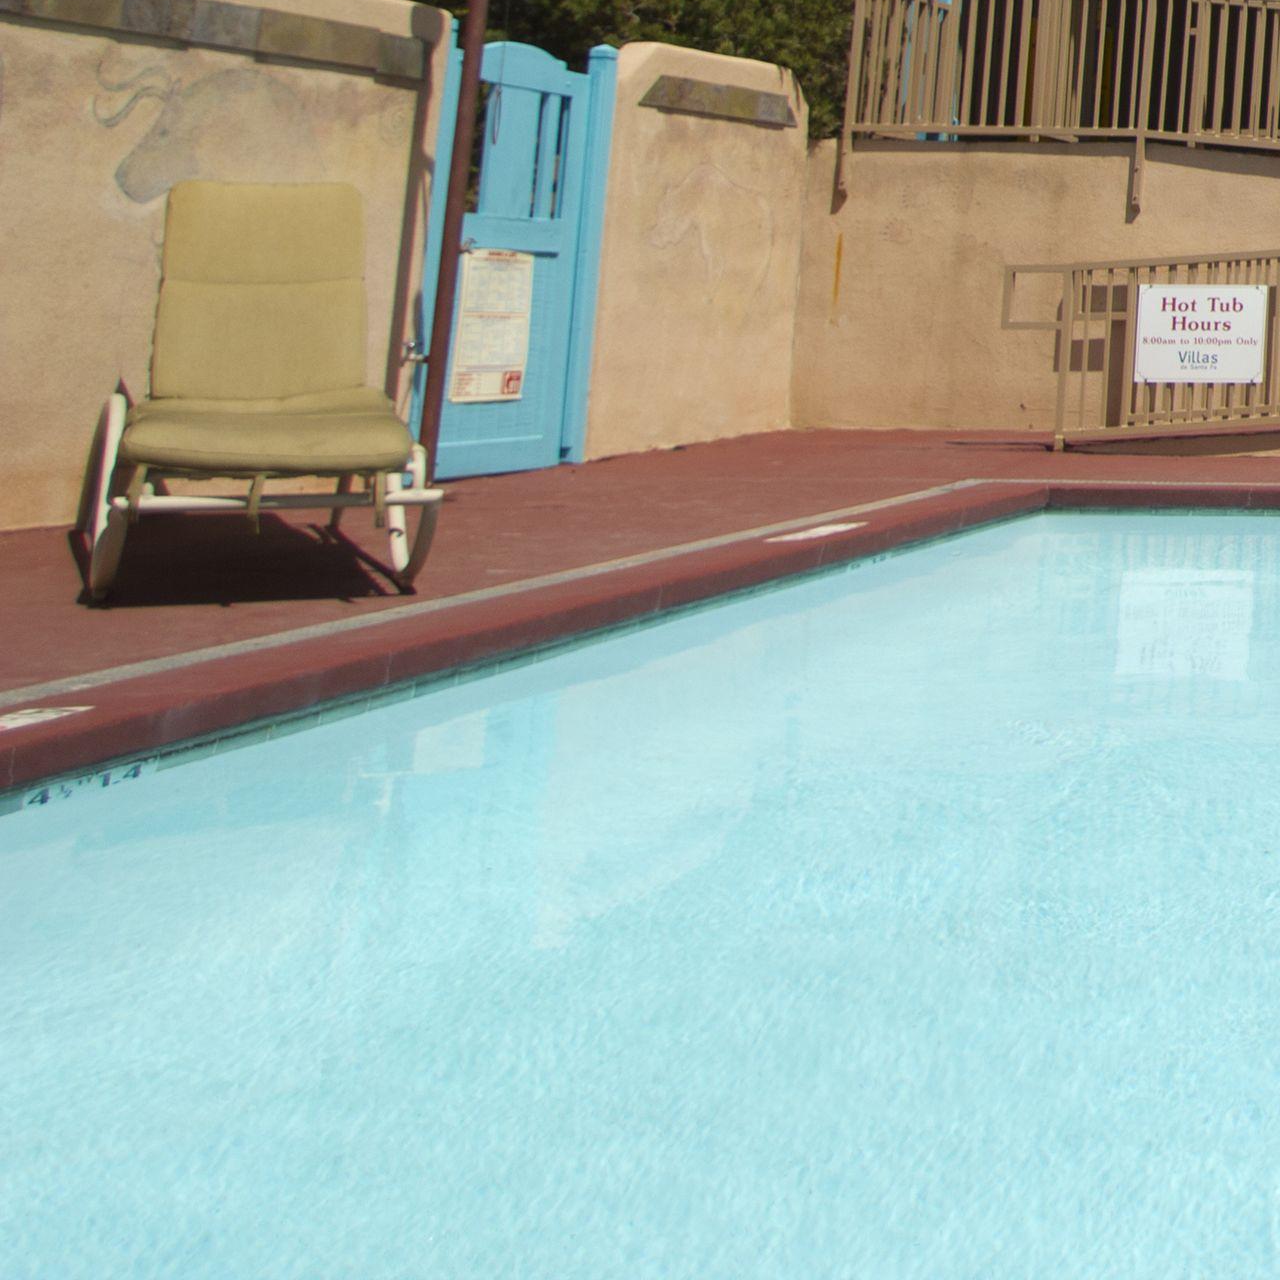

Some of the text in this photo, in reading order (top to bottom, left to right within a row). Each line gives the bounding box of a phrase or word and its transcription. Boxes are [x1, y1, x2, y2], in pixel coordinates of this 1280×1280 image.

[1161, 297, 1244, 313] Hot Tub
[1171, 316, 1232, 331] Hours
[1180, 337, 1190, 345] to
[1236, 336, 1258, 347] Only
[1178, 351, 1219, 364] Villas
